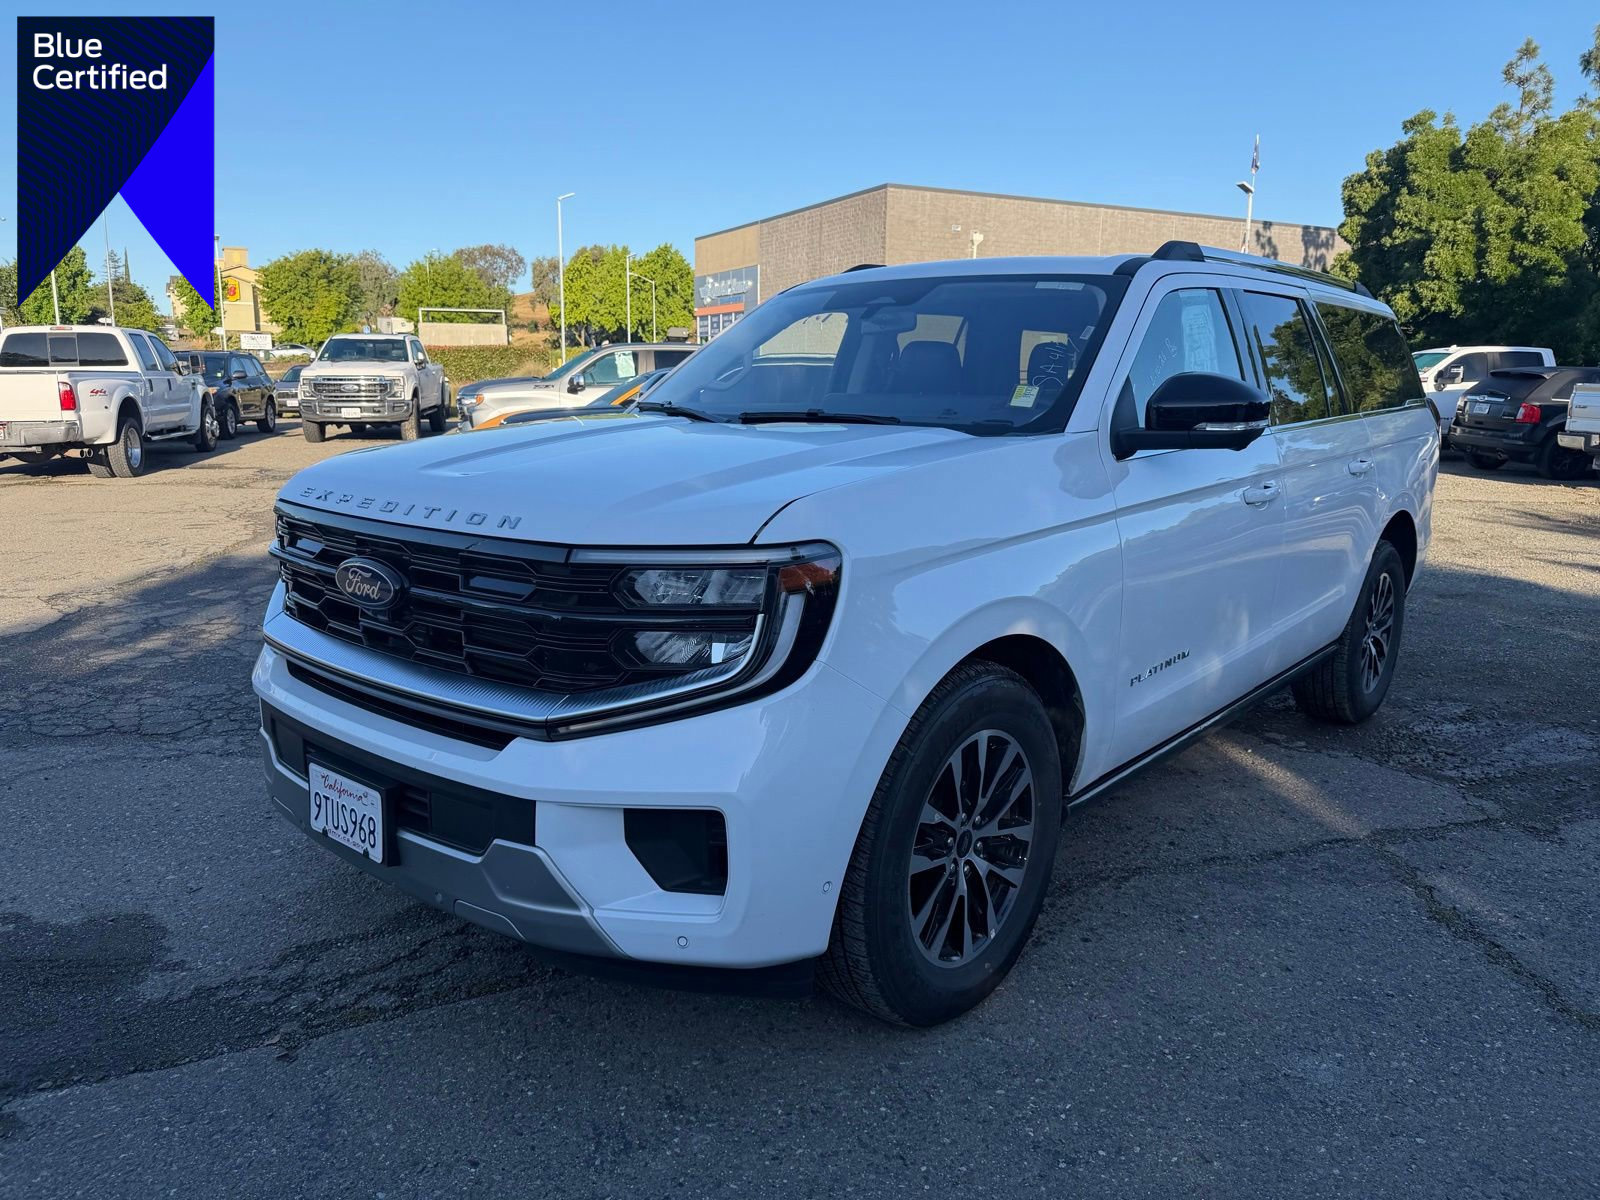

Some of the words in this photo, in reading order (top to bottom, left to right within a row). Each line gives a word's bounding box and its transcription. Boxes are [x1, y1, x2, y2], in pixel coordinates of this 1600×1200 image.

[300, 487, 523, 530] EXPEDITION
[345, 567, 381, 600] Ford
[1129, 648, 1190, 687] PLATINUM
[323, 774, 367, 806] California
[314, 791, 376, 849] 9TUS968
